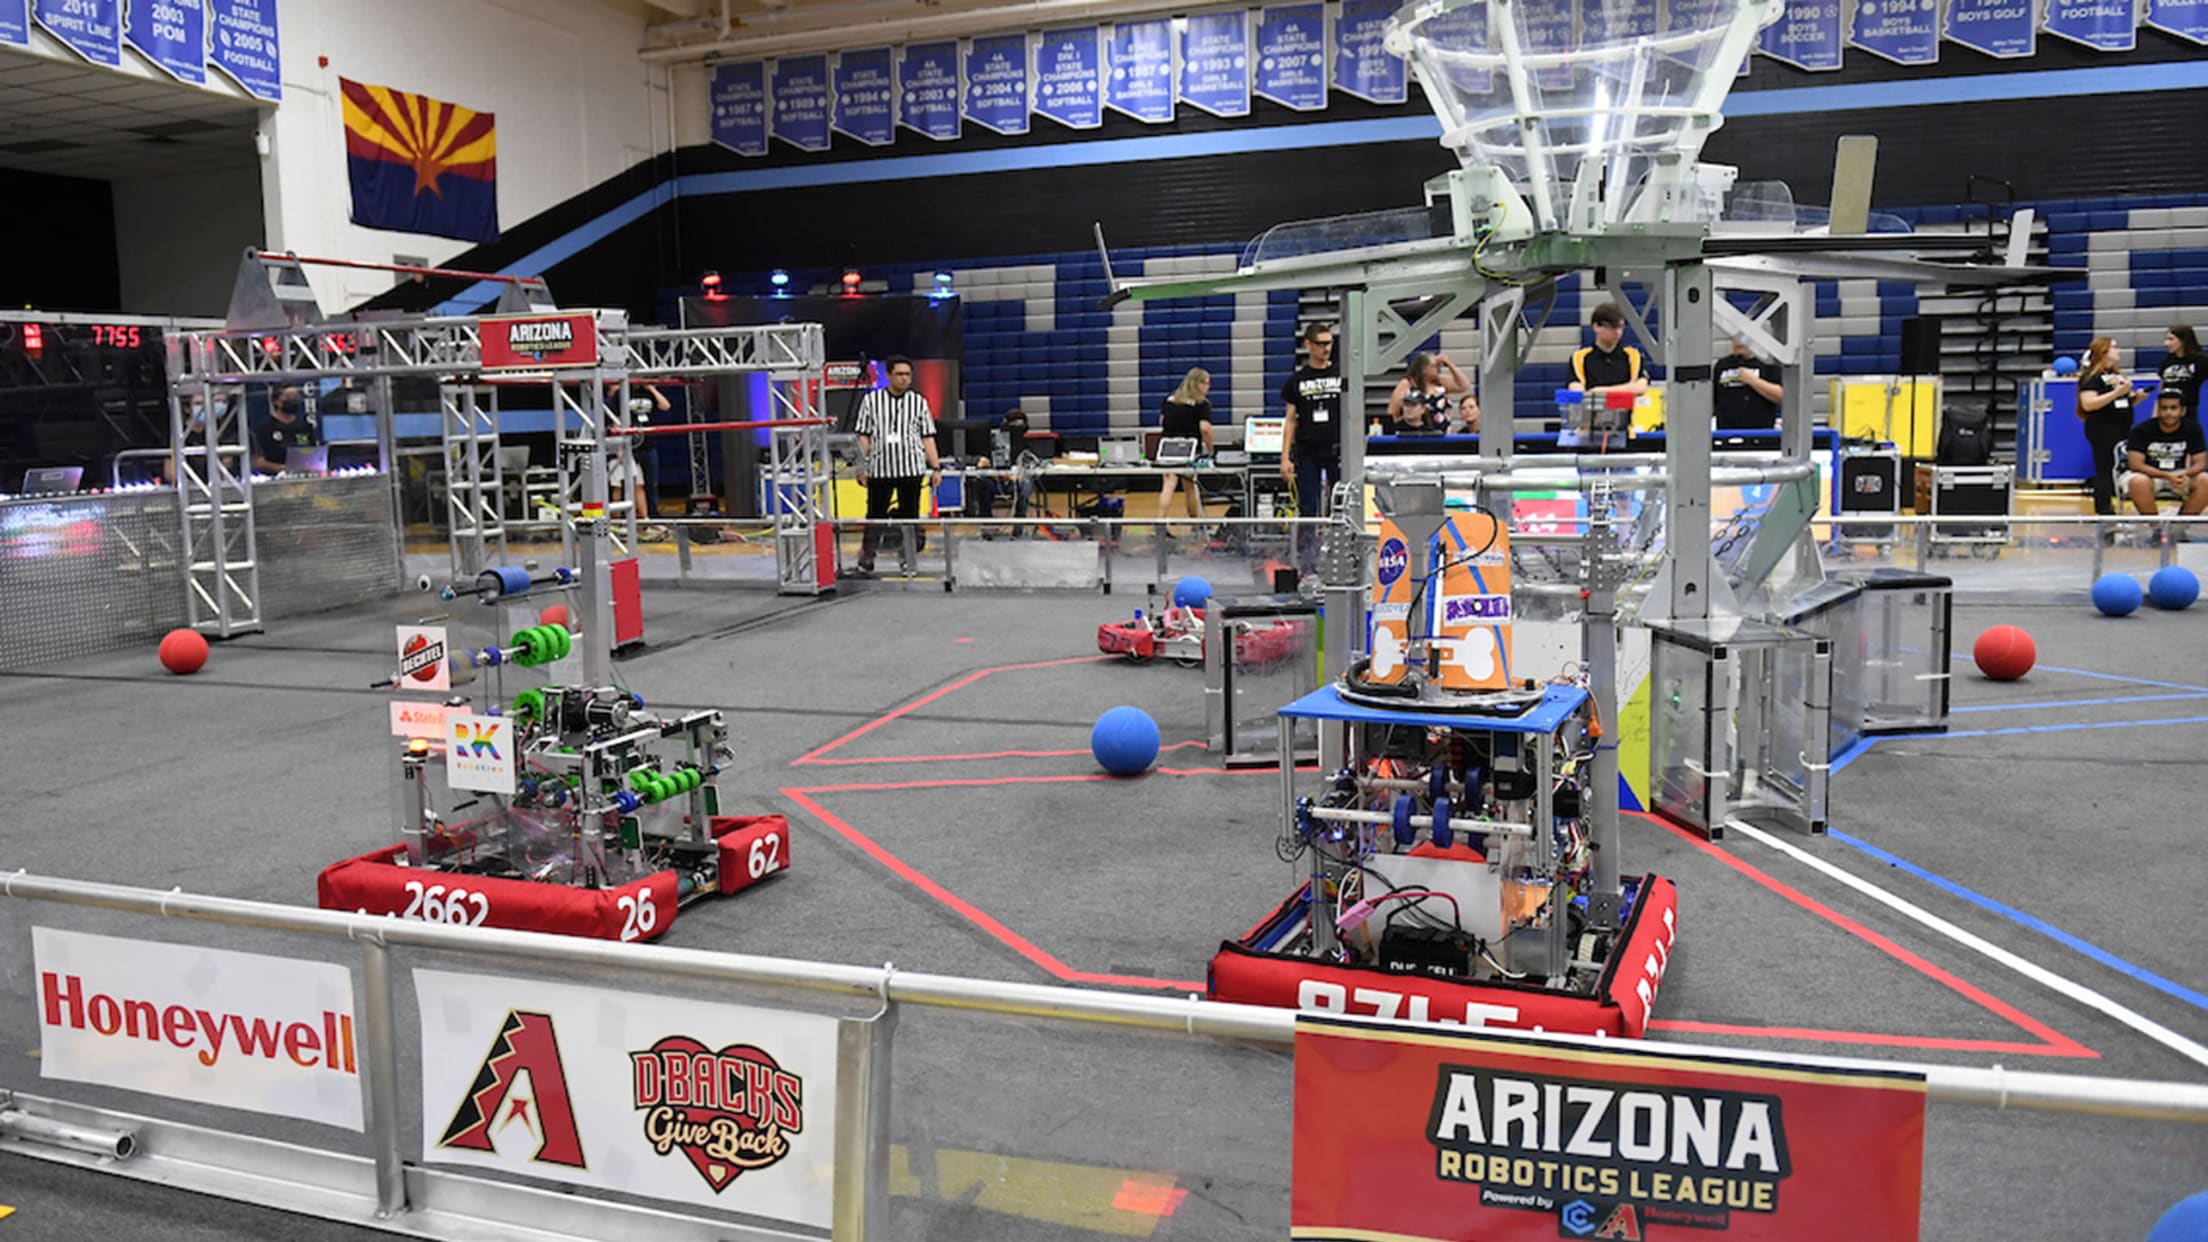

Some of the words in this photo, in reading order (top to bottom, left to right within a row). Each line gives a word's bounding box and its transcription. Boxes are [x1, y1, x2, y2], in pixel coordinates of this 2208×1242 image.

[1882, 0, 1916, 13] 1994
[2061, 6, 2126, 19] FOOTBALL
[152, 4, 184, 24] 2003
[231, 5, 260, 24] STATE
[1787, 6, 1820, 21] 1990
[1957, 10, 1991, 22] BOYS
[1993, 7, 2026, 20] GOLF
[44, 12, 85, 32] SPIRIT
[87, 22, 112, 40] LINE
[218, 13, 275, 38] CHAMPIONS
[1788, 23, 1817, 33] BOYS
[1882, 17, 1911, 27] BOYS
[152, 23, 186, 43] POM
[1781, 32, 1825, 43] SOCCER
[1863, 25, 1932, 37] BASKETBALL
[233, 32, 263, 52] 2005
[1201, 34, 1229, 45] STATE
[1277, 32, 1306, 44] STATE
[1188, 42, 1244, 56] CHAMPIONS
[1263, 40, 1320, 55] CHAMPIONS
[223, 50, 274, 72] FOOTBALL
[1114, 50, 1169, 64] CHAMPIONS
[1277, 53, 1306, 67] 2007
[985, 61, 1011, 71] STATE
[1055, 61, 1083, 72] STATE
[852, 70, 877, 81] STATE
[918, 68, 943, 79] STATE
[972, 69, 1024, 82] CHAMPIONS
[1043, 68, 1096, 82] CHAMPIONS
[841, 78, 889, 90] CHAMPIONS
[905, 76, 955, 89] CHAMPIONS
[1189, 80, 1244, 93] BASKETBALL
[1267, 76, 1318, 88] BASKETBALL
[716, 90, 762, 102] CHAMPIONS
[777, 84, 825, 96] CHAMPIONS
[1116, 88, 1168, 100] BASKETBALL
[976, 97, 1022, 109] SOFTBALL
[1047, 95, 1093, 107] SOFTBALL
[845, 104, 888, 116] SOFTBALL
[909, 103, 953, 115] SOFTBALL
[720, 116, 761, 128] SOFTBALL
[782, 111, 824, 122] SOFTBALL
[91, 325, 140, 348] 7755
[510, 322, 572, 342] ARIZONA
[402, 645, 441, 673] BECHTEL
[747, 834, 781, 878] 62
[402, 881, 489, 928] 2662
[617, 887, 657, 941] 26
[42, 972, 356, 1074] Honeywell
[1436, 1073, 1780, 1173] ARIZONA
[646, 1108, 711, 1156] Give
[709, 1119, 791, 1168] Back
[1440, 1151, 1619, 1196] ROBOTICS
[1629, 1173, 1778, 1211] LEAGUE
[1483, 1190, 1535, 1207] Powered
[1537, 1196, 1554, 1209] by
[1644, 1206, 1726, 1225] Honeywell
